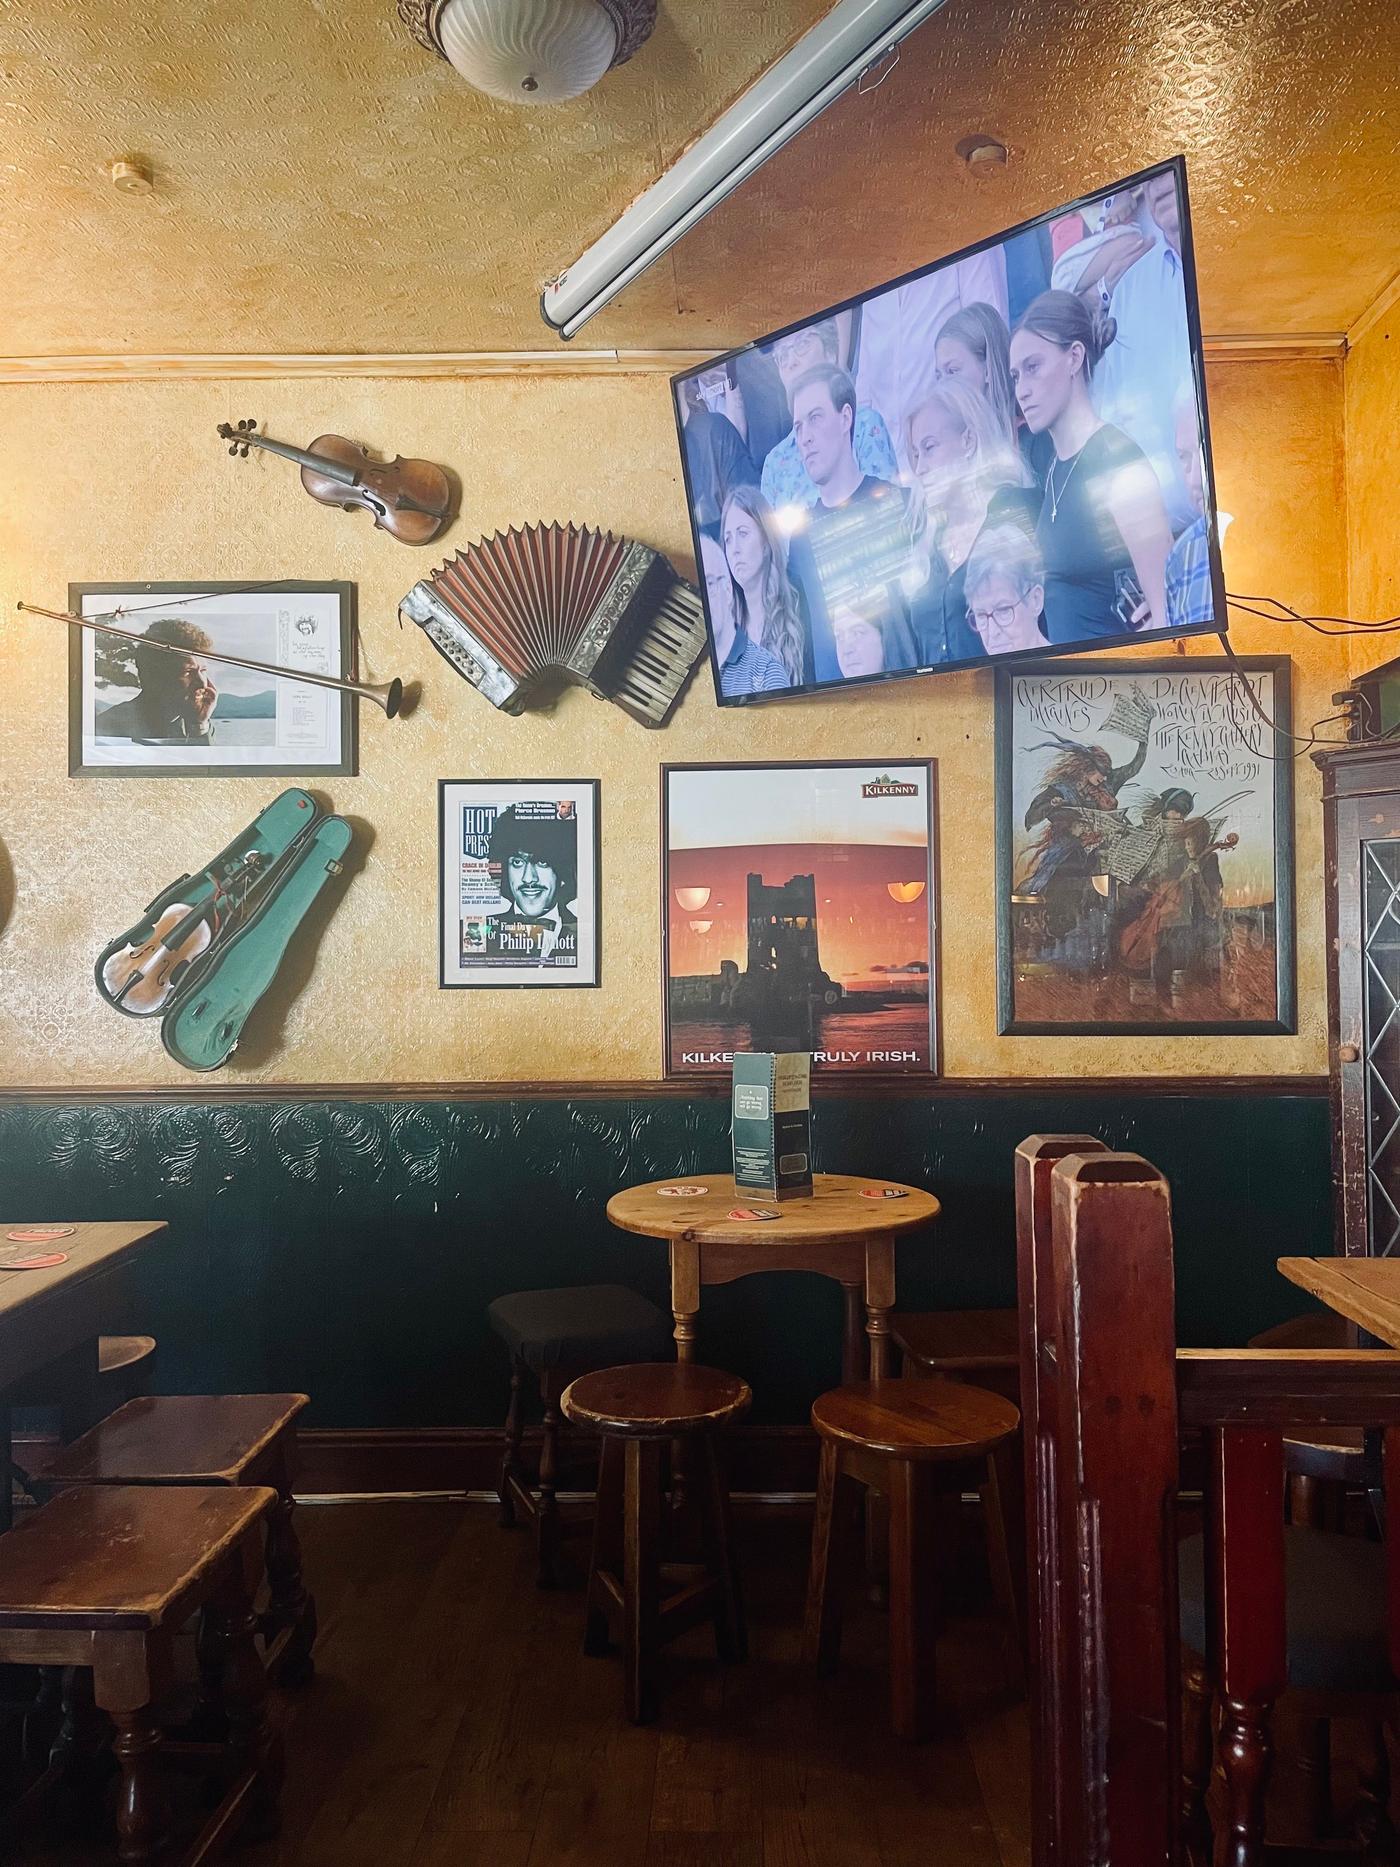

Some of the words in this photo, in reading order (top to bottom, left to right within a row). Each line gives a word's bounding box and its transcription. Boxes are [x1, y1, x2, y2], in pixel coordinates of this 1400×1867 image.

[1017, 676, 1119, 708] GERTRUDE
[865, 785, 915, 795] KILKENNY
[465, 809, 495, 834] HOT
[465, 834, 493, 856] PRES
[488, 917, 499, 926] The
[501, 922, 516, 931] Final
[488, 930, 496, 940] Of
[500, 933, 534, 954] Philip
[866, 1051, 921, 1062] IRISH.
